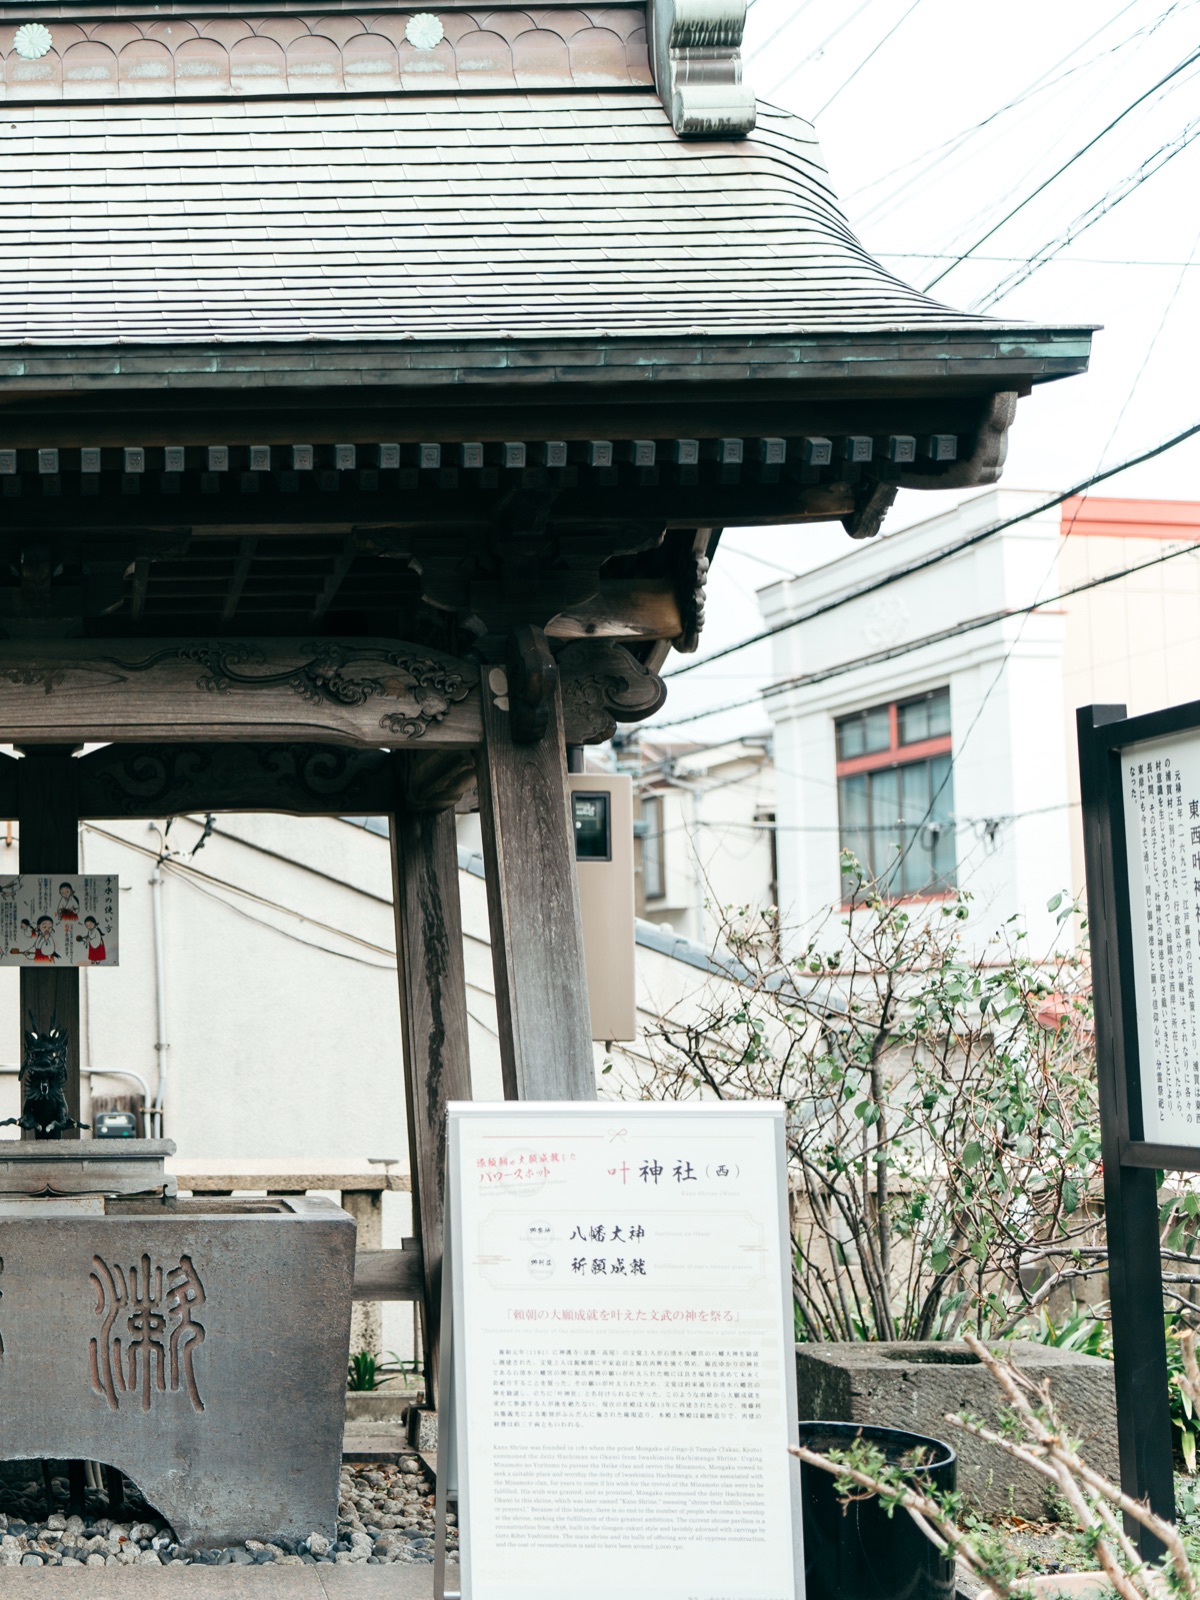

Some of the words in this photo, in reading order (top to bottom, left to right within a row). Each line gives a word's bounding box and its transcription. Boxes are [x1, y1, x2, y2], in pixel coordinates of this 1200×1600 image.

[1129, 766, 1138, 804] なった。
[104, 876, 114, 934] 手水の使い方
[569, 1225, 645, 1244] 八幡大神
[571, 1257, 647, 1277] 祈願成就
[506, 1308, 741, 1323] 「頼朝の大願成就を叶えた文武の神を祭る」
